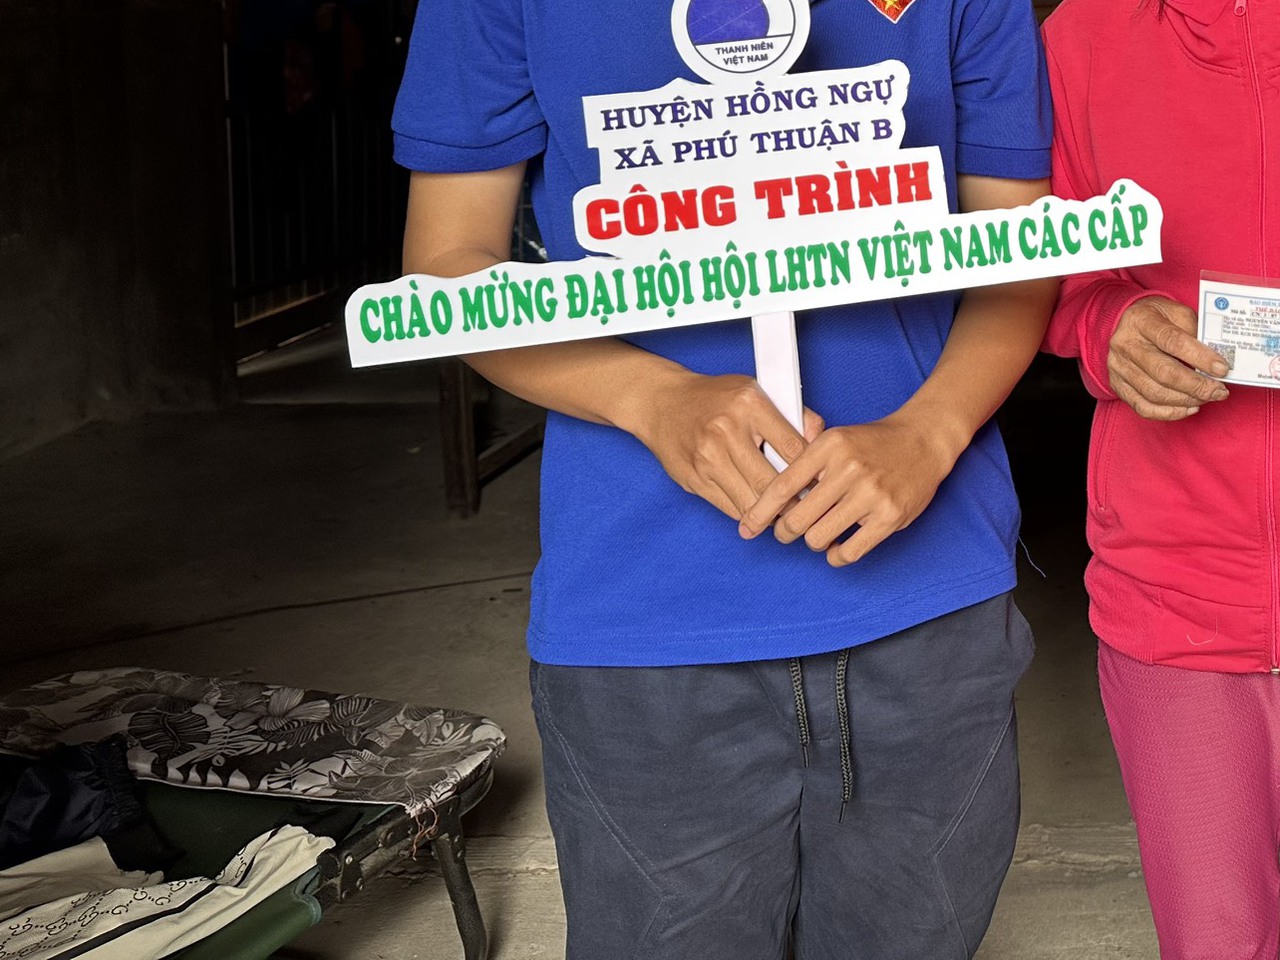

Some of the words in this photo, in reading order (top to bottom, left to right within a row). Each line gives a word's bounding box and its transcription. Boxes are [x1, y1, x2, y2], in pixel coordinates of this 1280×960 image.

[715, 44, 749, 55] THANH
[751, 41, 774, 51] NIÊN
[723, 55, 745, 66] VIỆT
[747, 53, 769, 63] NAM
[601, 96, 713, 132] HUYỆN
[724, 81, 817, 118] HỒNG
[828, 74, 894, 107] NGỰ
[614, 139, 663, 170] XÃ
[672, 130, 738, 163] PHÚ
[750, 118, 861, 160] THUẬN
[871, 119, 893, 141] B
[586, 184, 737, 241] CÔNG
[754, 160, 933, 220] TRÌNH
[359, 279, 453, 345] CHÀO
[457, 270, 558, 333] MỪNG
[564, 269, 628, 325] ĐẠI
[633, 249, 694, 318] HỘI
[700, 241, 760, 309] HỘI
[765, 241, 852, 294] LHTN
[858, 220, 933, 287] VIỆT
[940, 221, 1013, 272] NAM
[1019, 202, 1081, 261] CÁC
[1087, 184, 1149, 252] CẤP
